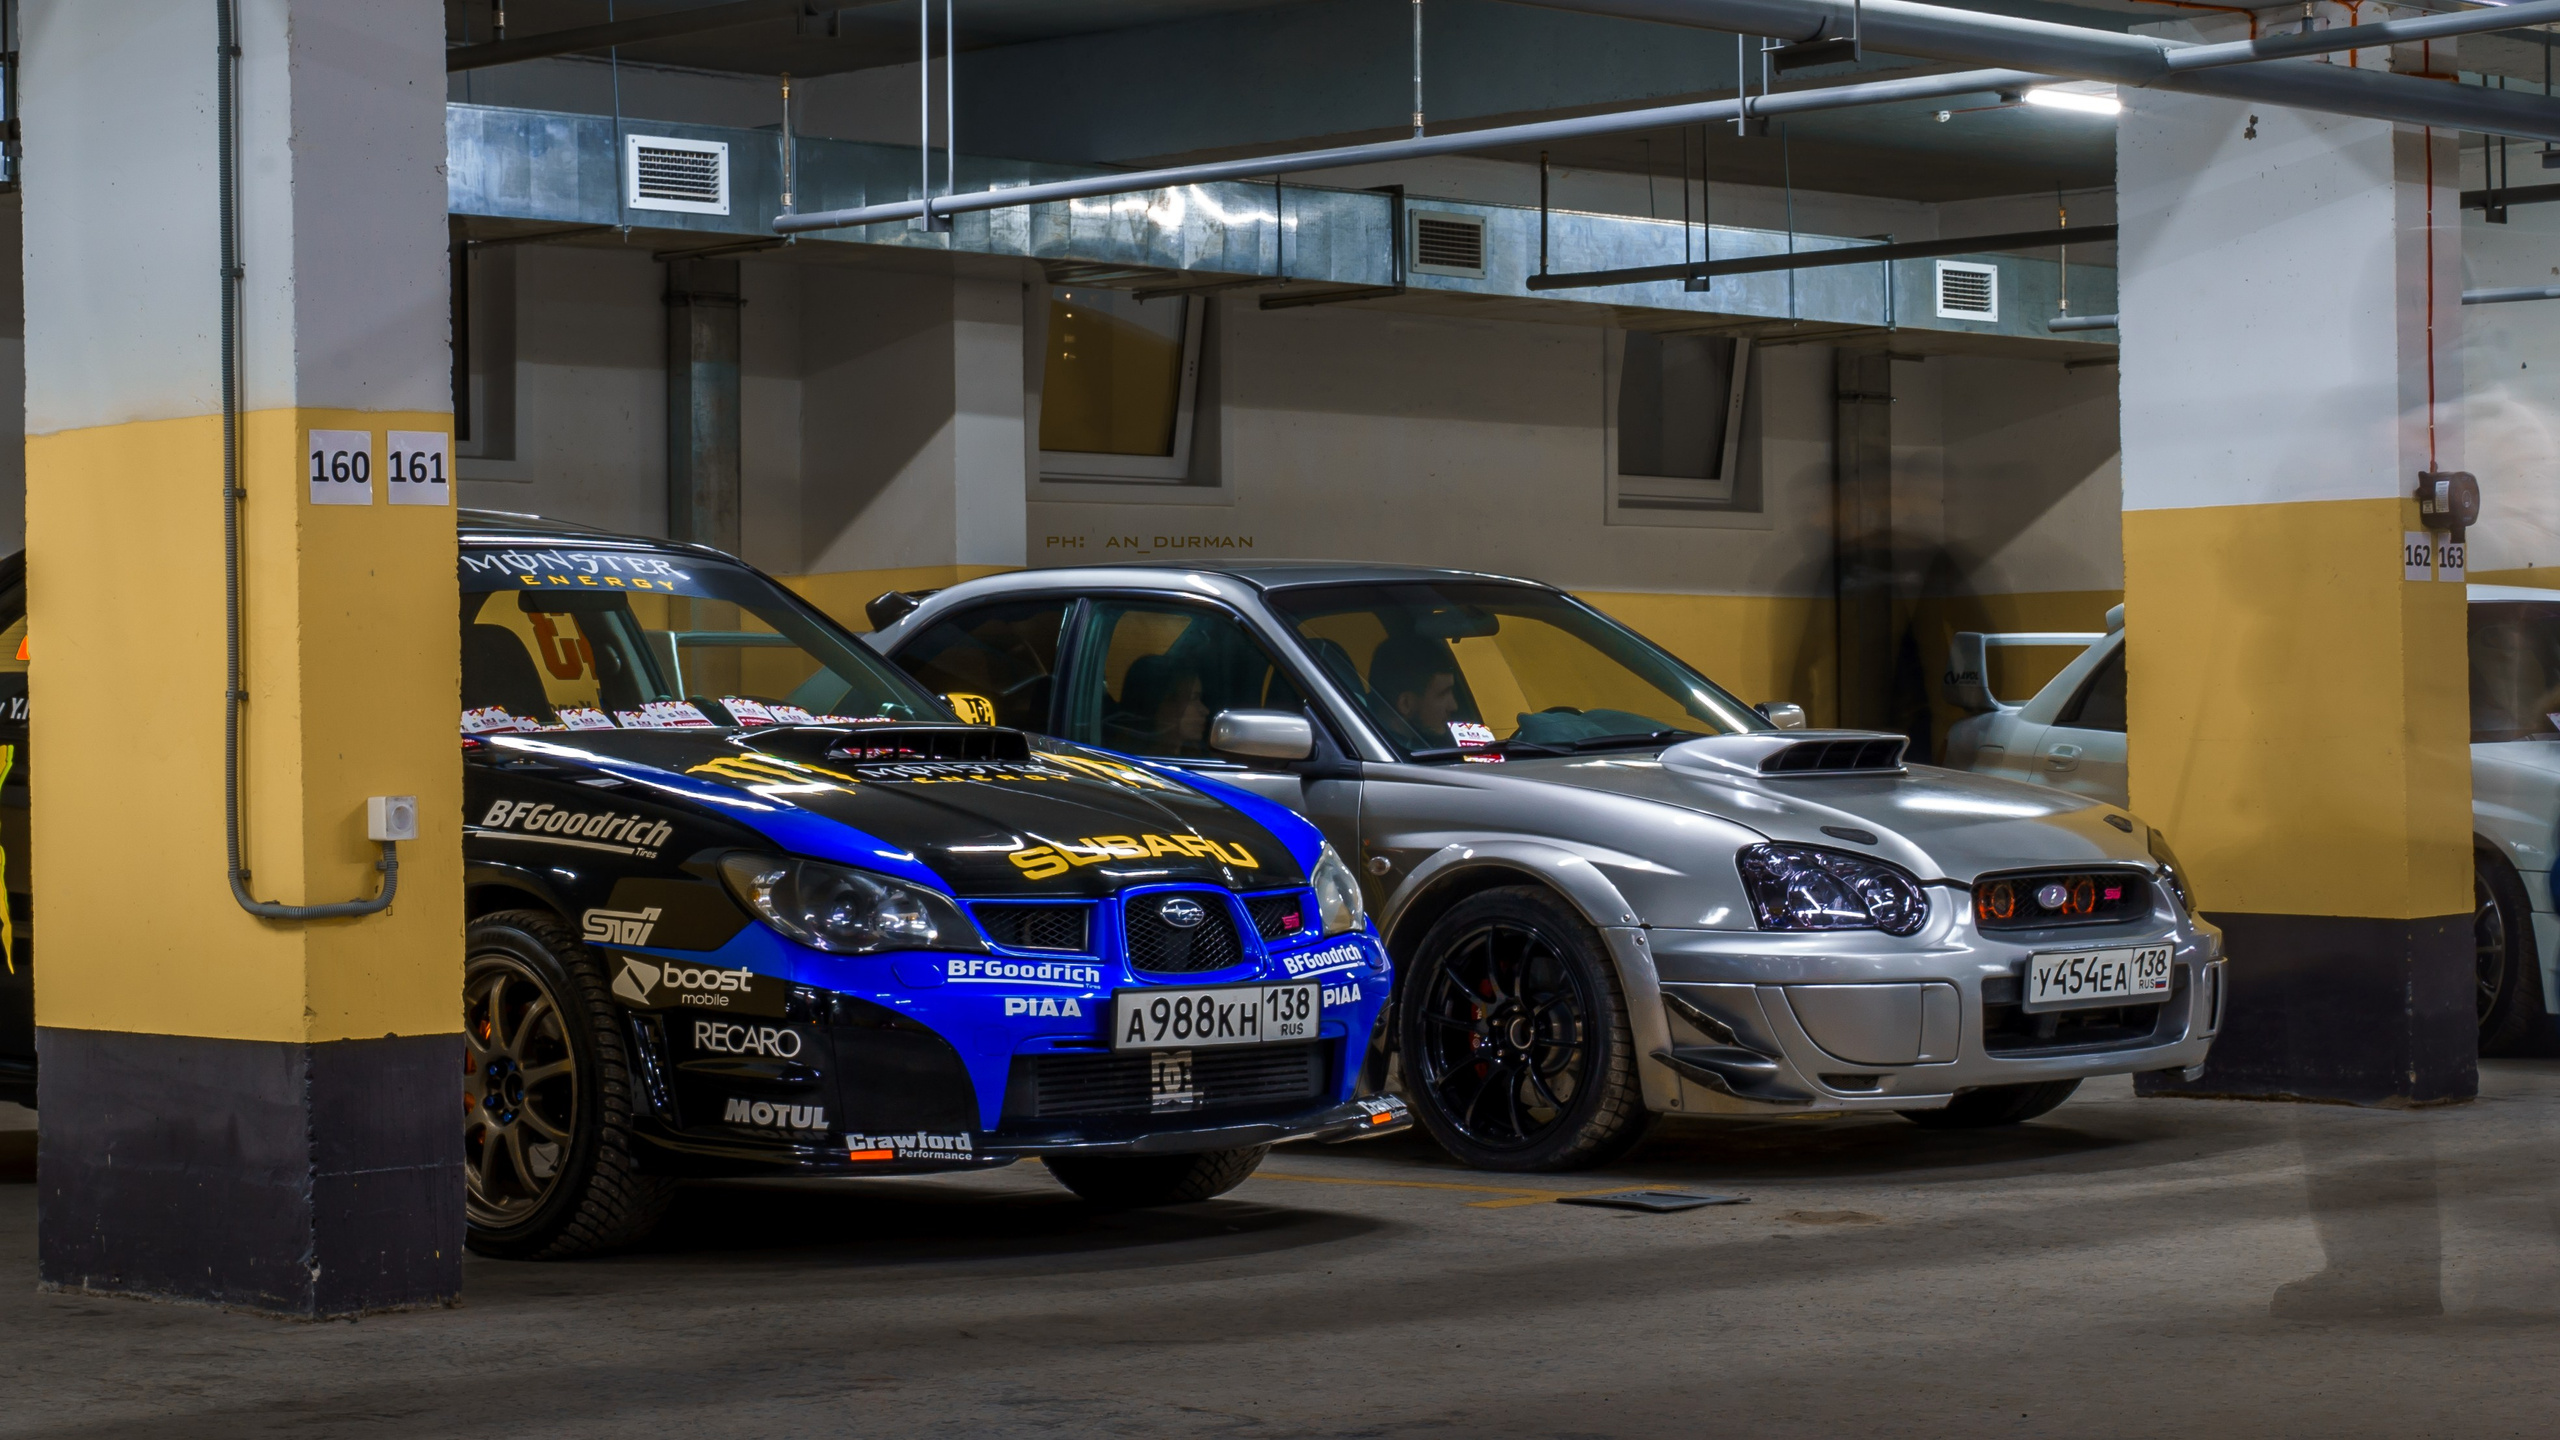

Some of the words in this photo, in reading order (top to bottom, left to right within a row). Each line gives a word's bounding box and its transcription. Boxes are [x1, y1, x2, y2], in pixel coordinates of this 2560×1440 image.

[311, 450, 370, 483] 160
[390, 451, 446, 483] 161
[2405, 545, 2431, 567] 162
[2439, 547, 2464, 568] 163
[520, 575, 674, 591] ENERGY
[912, 774, 1070, 785] ENERGY
[482, 800, 672, 847] BFGoodrich
[636, 847, 657, 859] Tires
[1009, 834, 1258, 880] SUBARU
[1283, 944, 1362, 975] BFGoodrich
[2135, 949, 2166, 978] 138
[663, 962, 753, 992] boost
[948, 960, 1100, 982] BFGoodrich
[1323, 983, 1361, 1008] PIAA
[2139, 980, 2155, 989] RUS
[682, 993, 729, 1006] mobile
[1005, 998, 1082, 1017] PIAA
[1266, 988, 1310, 1022] 138
[695, 1021, 801, 1058] RECARO
[1281, 1023, 1304, 1036] RUS
[724, 1099, 829, 1129] MOTUL
[846, 1131, 972, 1151] Crawford
[899, 1149, 972, 1160] Performance
